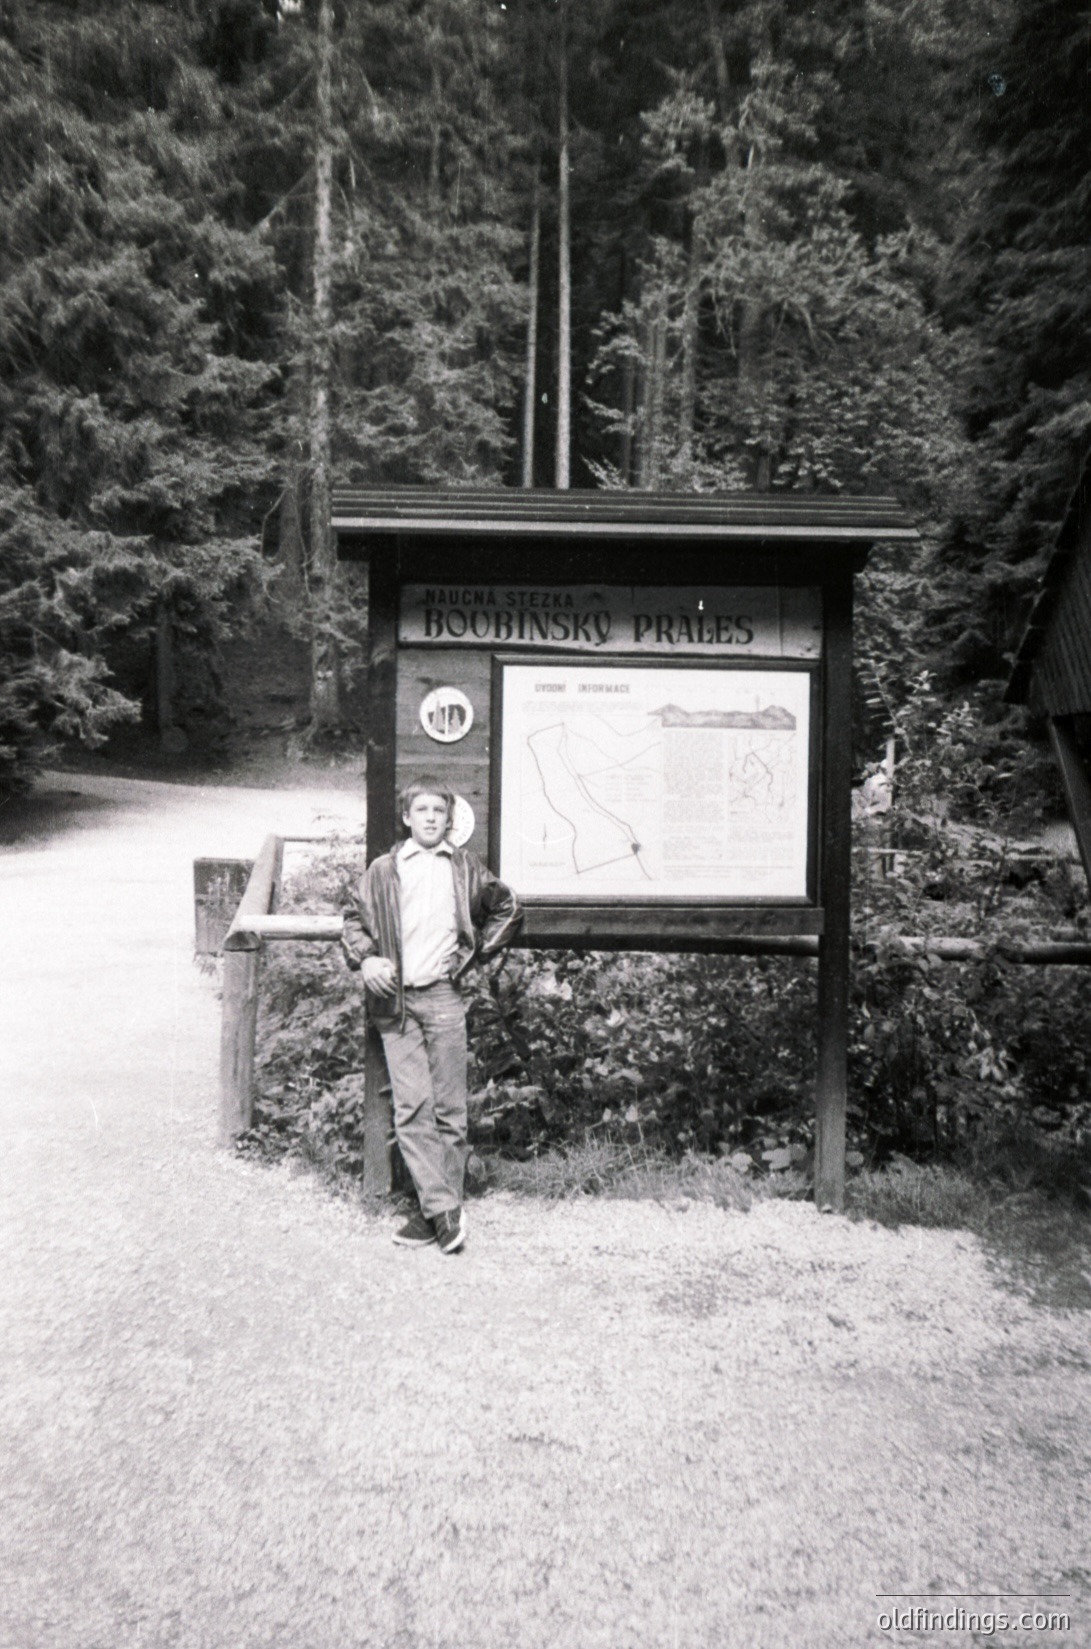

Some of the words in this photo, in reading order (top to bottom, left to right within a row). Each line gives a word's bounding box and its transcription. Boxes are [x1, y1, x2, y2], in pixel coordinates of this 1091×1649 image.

[505, 591, 575, 609] STEZKA
[632, 613, 754, 645] PRALES
[578, 683, 631, 694] INFORMACE
